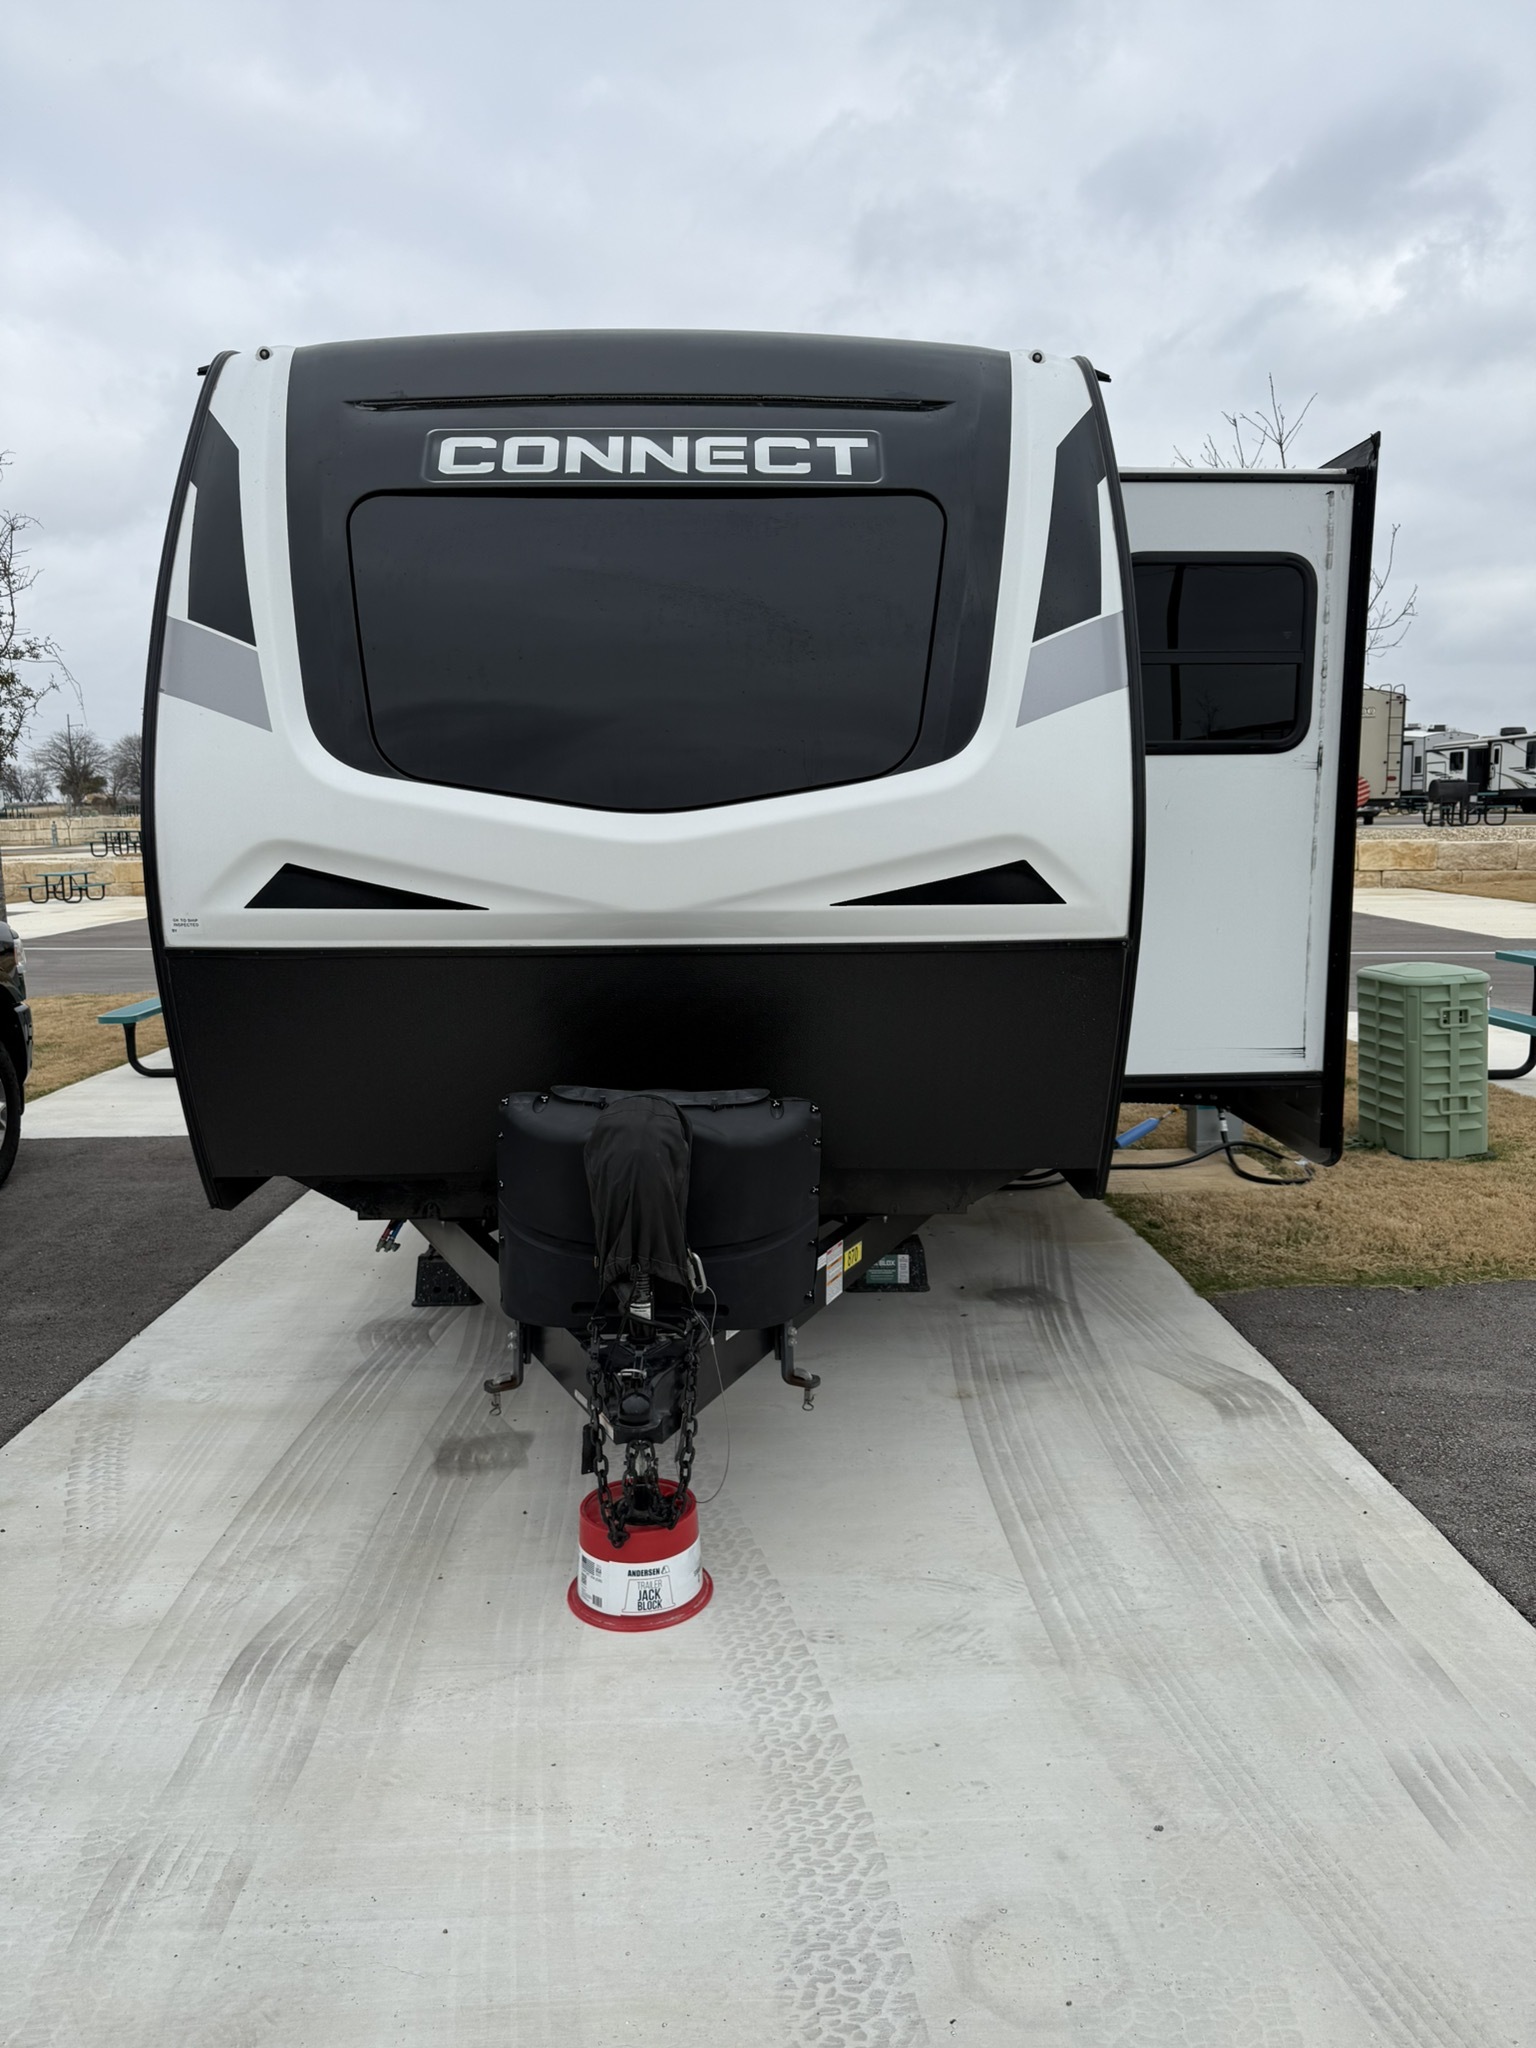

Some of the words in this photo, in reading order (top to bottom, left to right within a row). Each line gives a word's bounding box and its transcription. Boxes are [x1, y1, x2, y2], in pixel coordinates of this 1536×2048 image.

[438, 436, 869, 476] CONNECT
[627, 1568, 660, 1577] ANDERSEN
[637, 1580, 662, 1590] TRAILER
[637, 1588, 661, 1602] JACK
[637, 1600, 663, 1611] BLOCK
